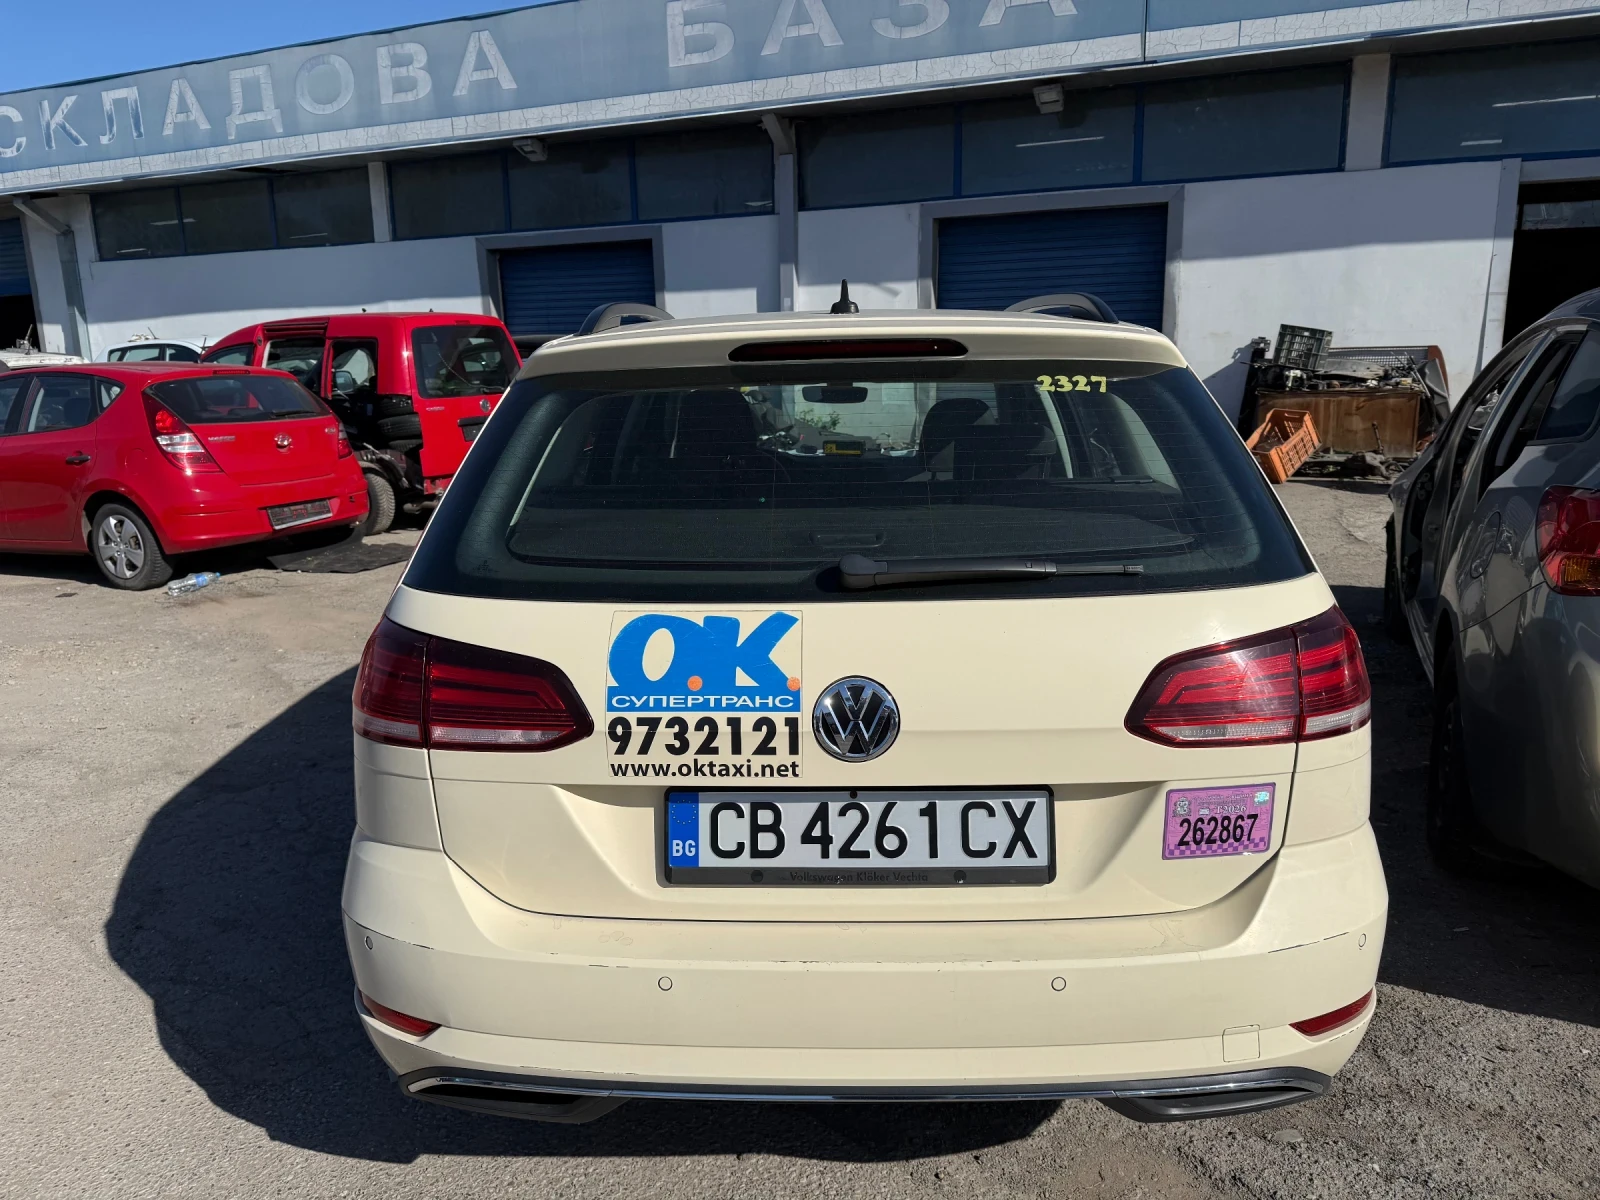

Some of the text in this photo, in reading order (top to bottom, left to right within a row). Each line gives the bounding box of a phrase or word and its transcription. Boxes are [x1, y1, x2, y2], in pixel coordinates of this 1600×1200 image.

[0, 30, 517, 158] СКЛАДОВА
[1036, 375, 1107, 393] 2327
[611, 695, 794, 708] СУПЕРТРАНС
[607, 716, 799, 756] 9732121
[610, 759, 800, 778] www.oktaxi.net
[709, 800, 1038, 860] CB 4261 CX
[1177, 813, 1259, 847] 262867
[672, 839, 696, 857] BG
[789, 871, 928, 885] Volkswagen Klöker Vechta
